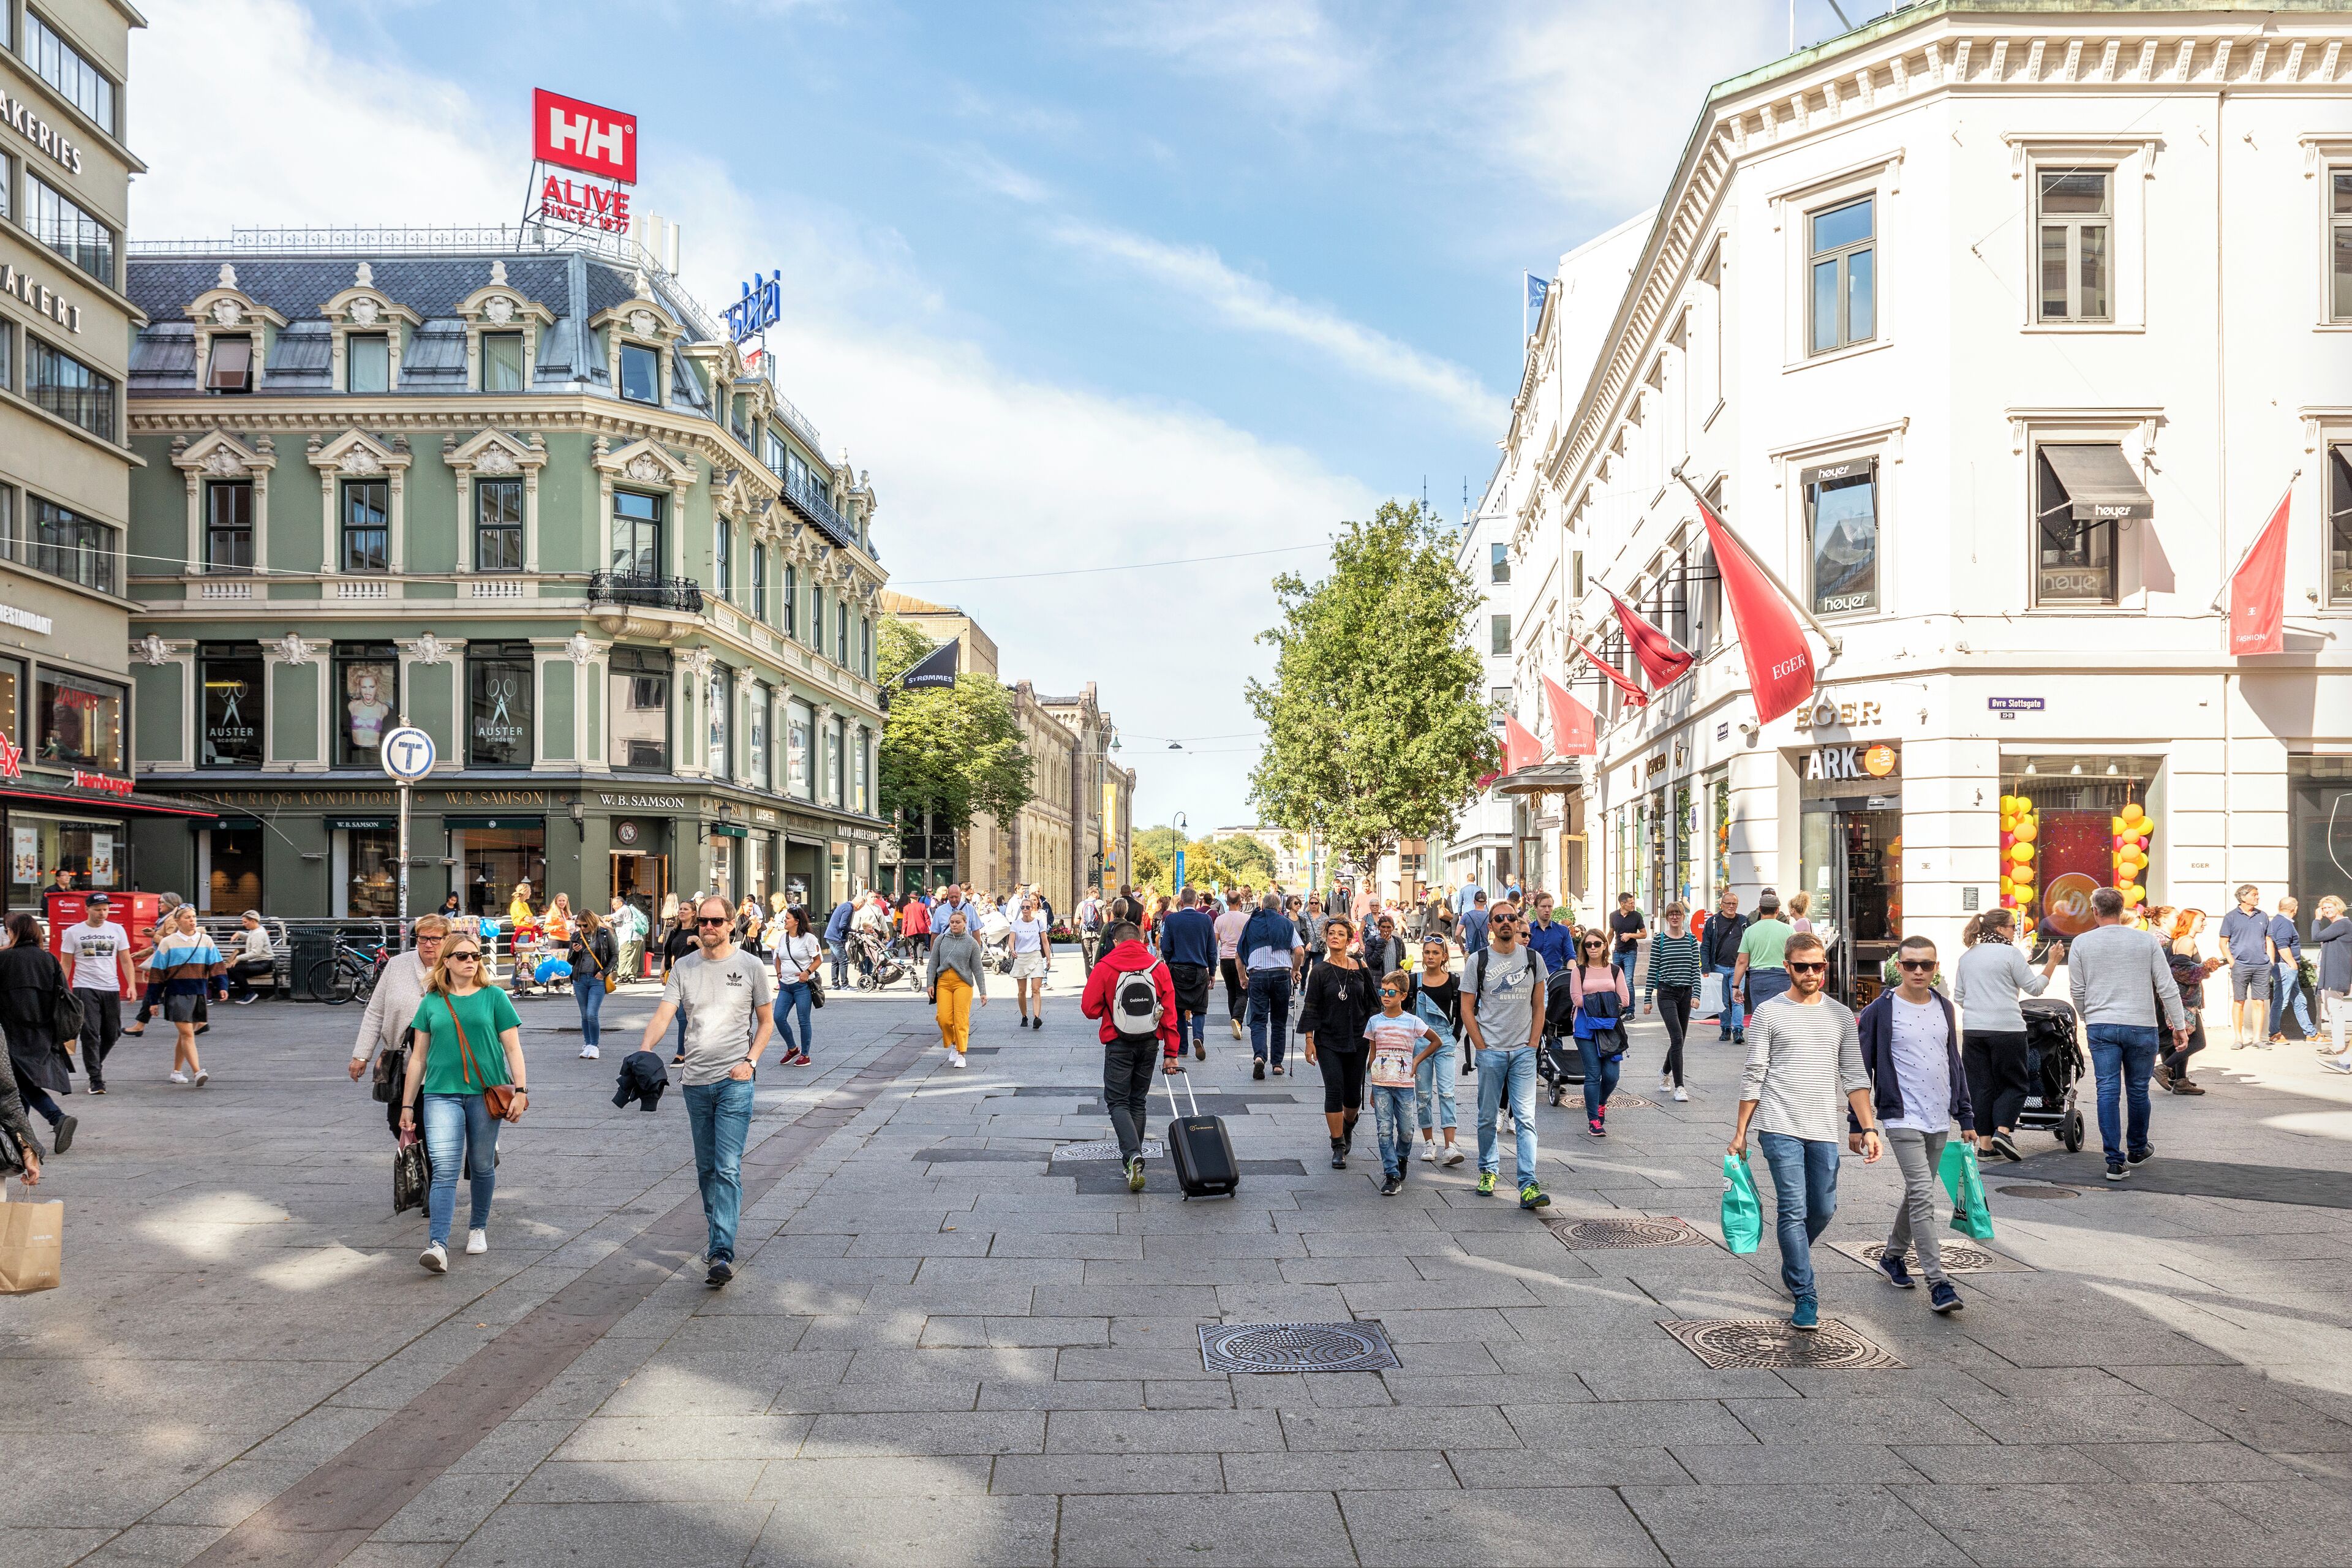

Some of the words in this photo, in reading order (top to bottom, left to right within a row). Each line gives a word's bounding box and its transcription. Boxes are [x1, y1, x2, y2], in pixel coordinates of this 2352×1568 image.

[550, 106, 623, 166] HH
[541, 175, 630, 220] ALIVE
[1818, 465, 1850, 480] høyer
[2095, 504, 2131, 518] høyer
[1824, 594, 1868, 611] høyer
[2236, 633, 2266, 643] FASHION
[1772, 653, 1806, 680] EGER
[908, 674, 953, 684] STRØMMES
[2008, 699, 2041, 709] Slottsgate
[1795, 701, 1882, 728] EGER
[209, 728, 254, 737] AUSTER
[478, 727, 522, 736] AUSTER
[398, 741, 423, 770] T
[1807, 746, 1860, 780] ARK
[74, 771, 135, 797] Hamburger
[271, 792, 292, 805] OG
[300, 792, 399, 805] KONDITORI
[445, 792, 461, 805] W.
[465, 791, 476, 805] B.
[480, 791, 543, 805] SAMSON
[600, 794, 614, 805] W.
[617, 795, 628, 805] B.
[631, 796, 685, 808] SAMSON
[756, 808, 769, 821] LUSH
[839, 825, 874, 841] DAVID-ANDERSEN
[1485, 960, 1512, 981] Smith
[1510, 974, 1521, 982] 1ST
